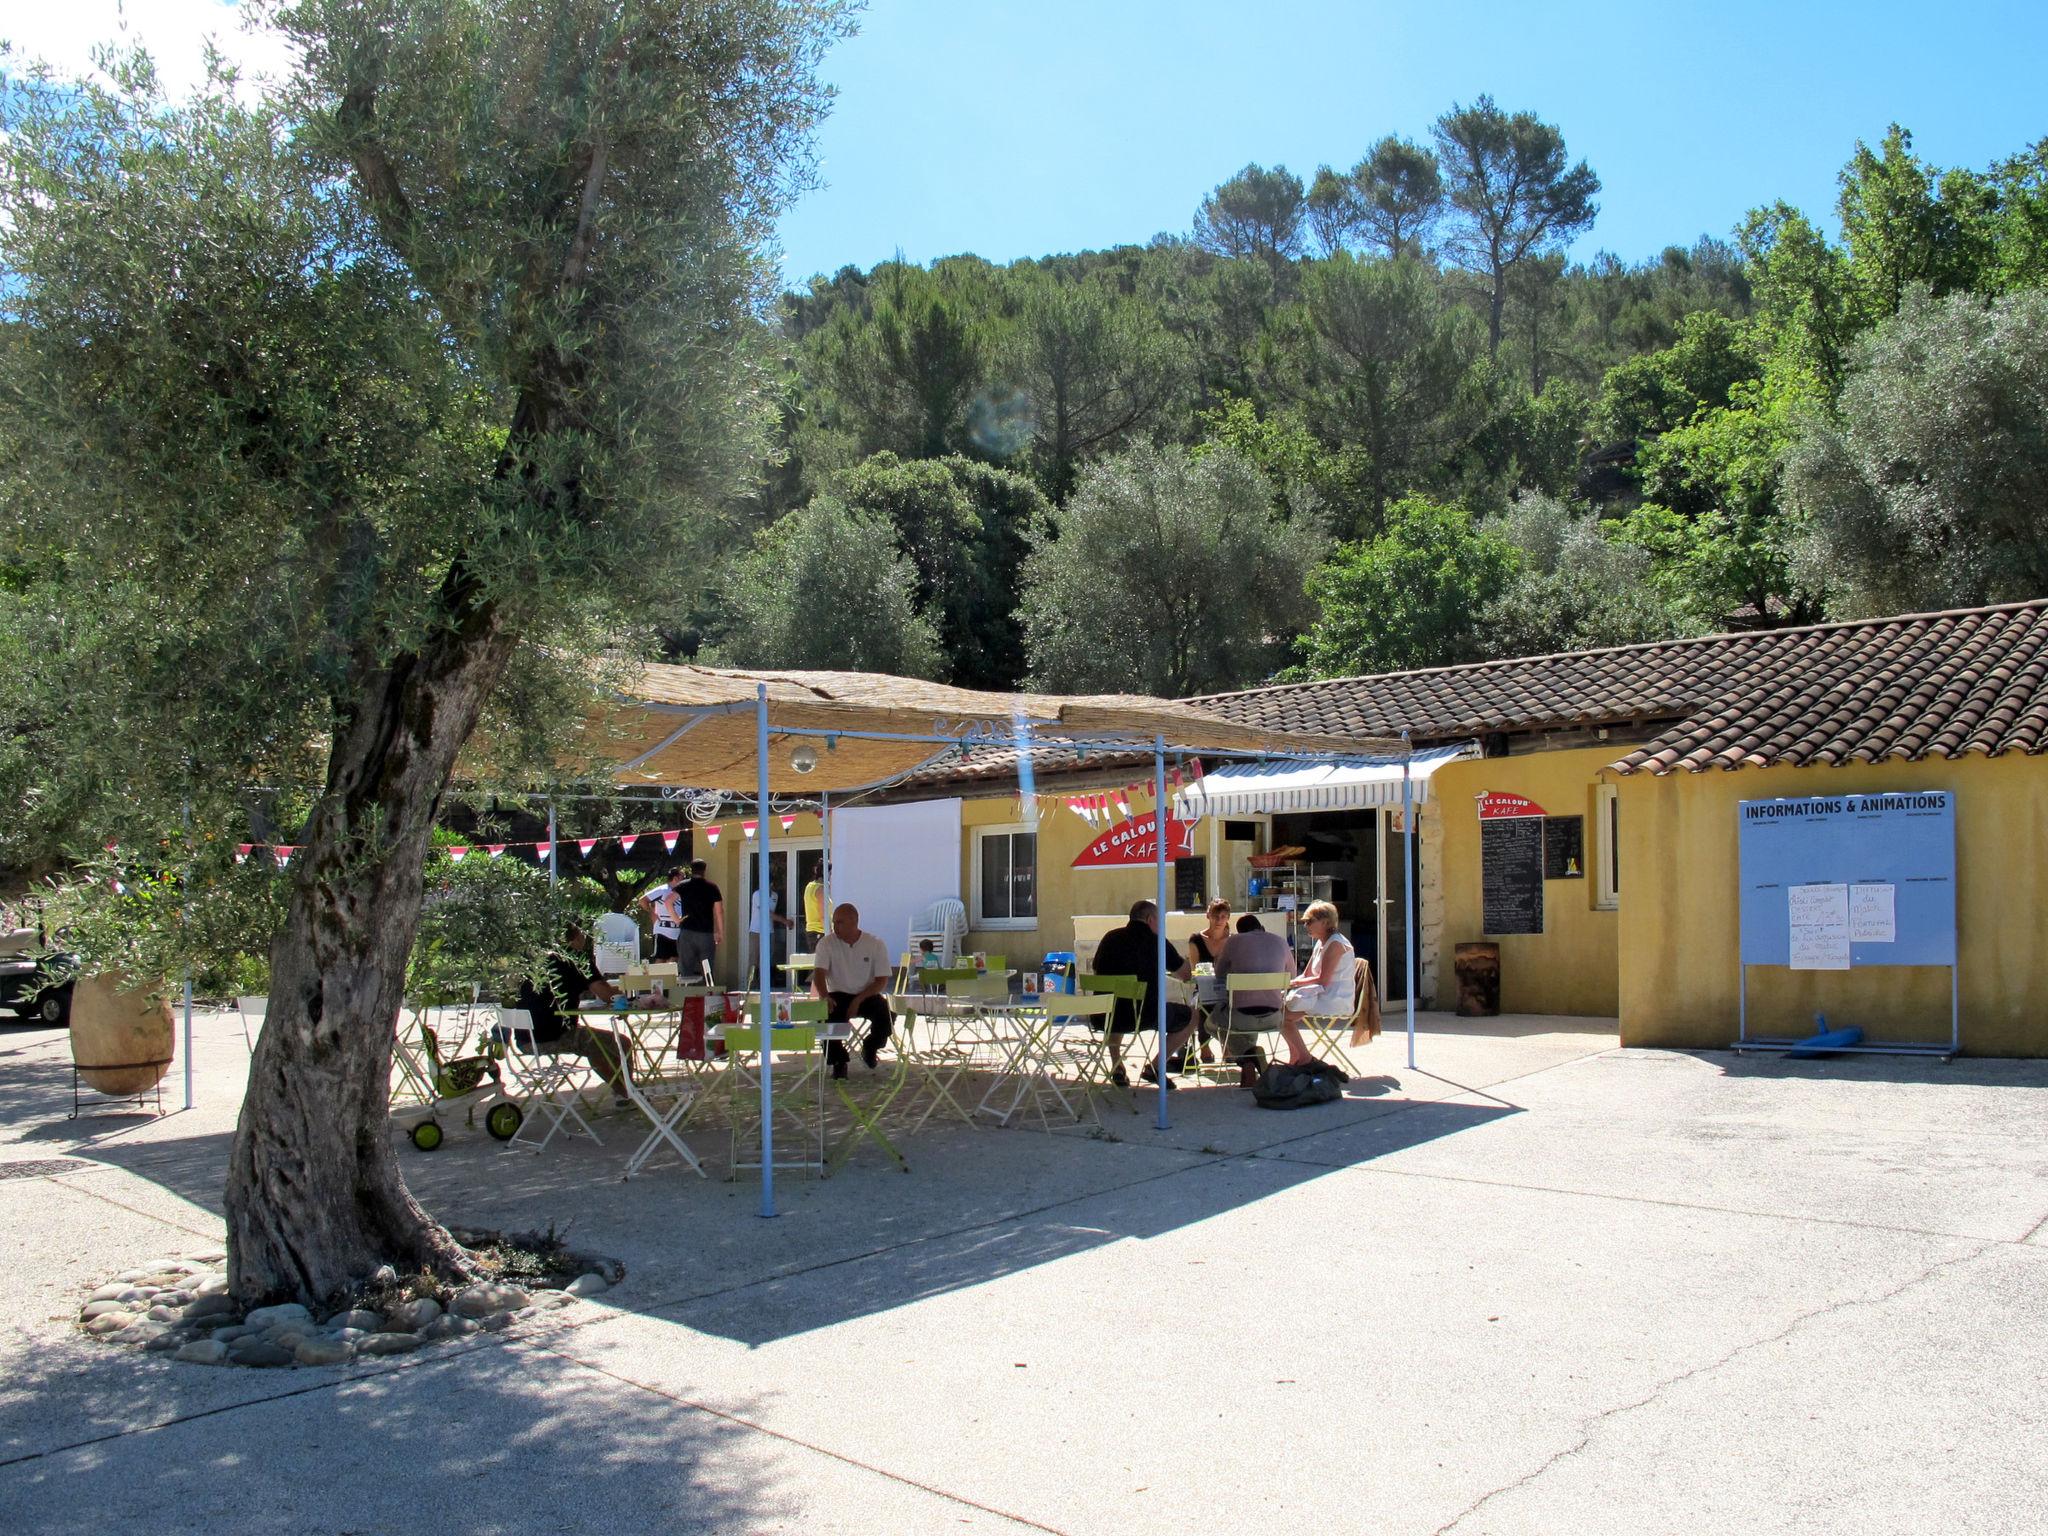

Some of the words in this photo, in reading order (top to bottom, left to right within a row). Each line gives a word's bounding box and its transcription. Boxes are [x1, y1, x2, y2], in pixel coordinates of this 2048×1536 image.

[1493, 807, 1519, 815] KAFE
[1746, 800, 1841, 819] INFORMATIONS
[1846, 800, 1856, 812] &
[1860, 795, 1945, 812] ANIMATIONS
[1092, 841, 1109, 857] LE
